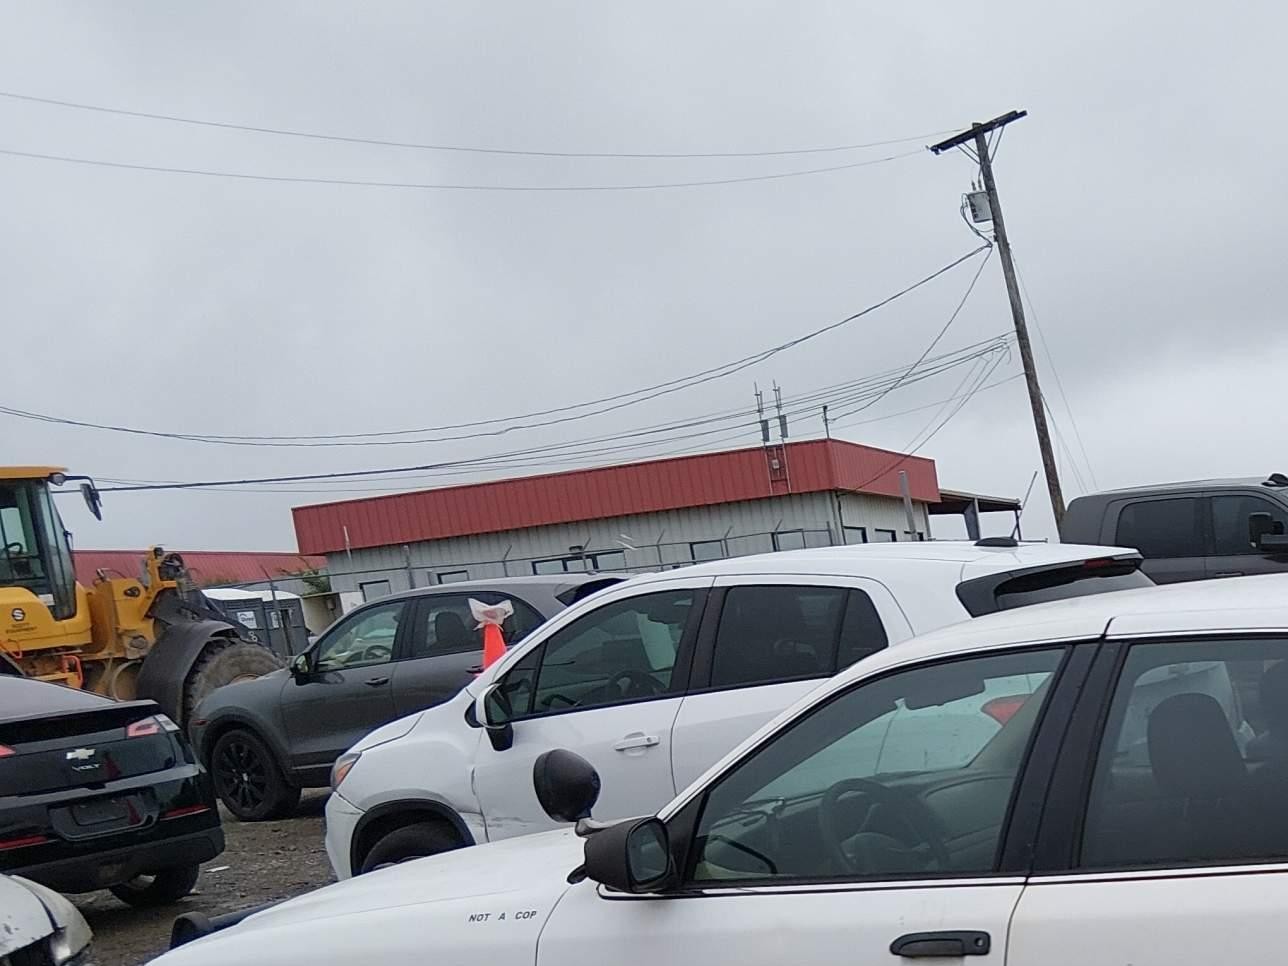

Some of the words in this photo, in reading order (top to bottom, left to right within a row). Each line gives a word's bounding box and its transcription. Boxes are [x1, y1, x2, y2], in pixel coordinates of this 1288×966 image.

[468, 913, 491, 922] NOT
[498, 911, 506, 920] A
[515, 910, 537, 919] COP
